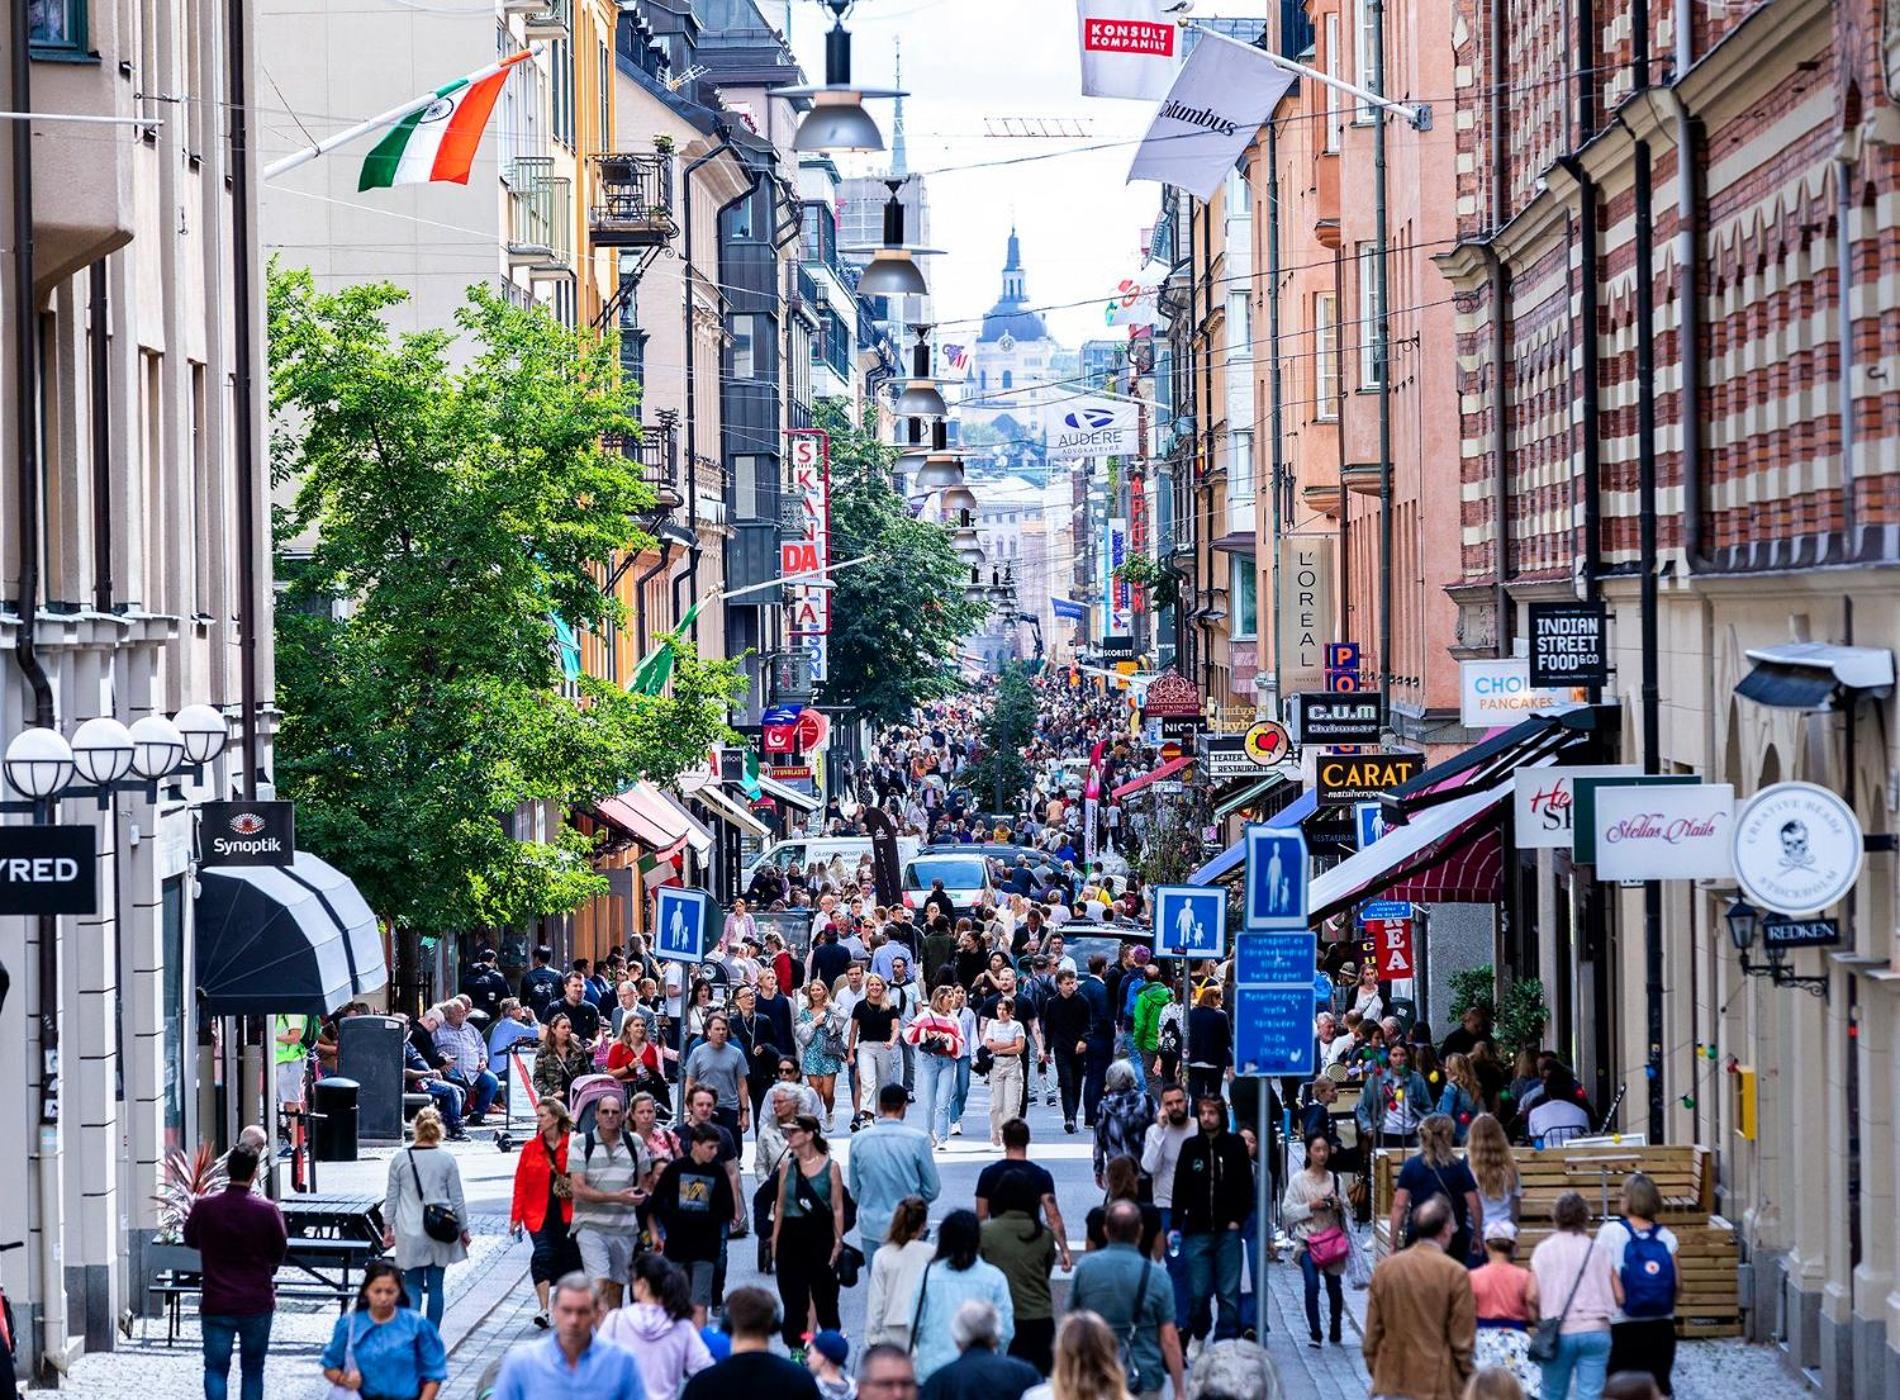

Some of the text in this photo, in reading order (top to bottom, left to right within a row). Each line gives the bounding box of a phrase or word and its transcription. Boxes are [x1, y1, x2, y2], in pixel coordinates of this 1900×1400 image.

[1091, 24, 1167, 40] KONSULT
[1159, 100, 1238, 137] olumbus
[1059, 431, 1123, 447] AUDERE
[1537, 618, 1599, 635] INDIAN
[1537, 636, 1599, 652] STREET
[1103, 649, 1133, 657] SCORETT
[1538, 654, 1578, 671] FOOD
[1480, 697, 1554, 710] PANCAKES
[1323, 763, 1412, 787] CARAT
[1606, 813, 1664, 844] Stellas
[213, 837, 281, 856] Synoptik
[1768, 923, 1835, 941] REDKEN
